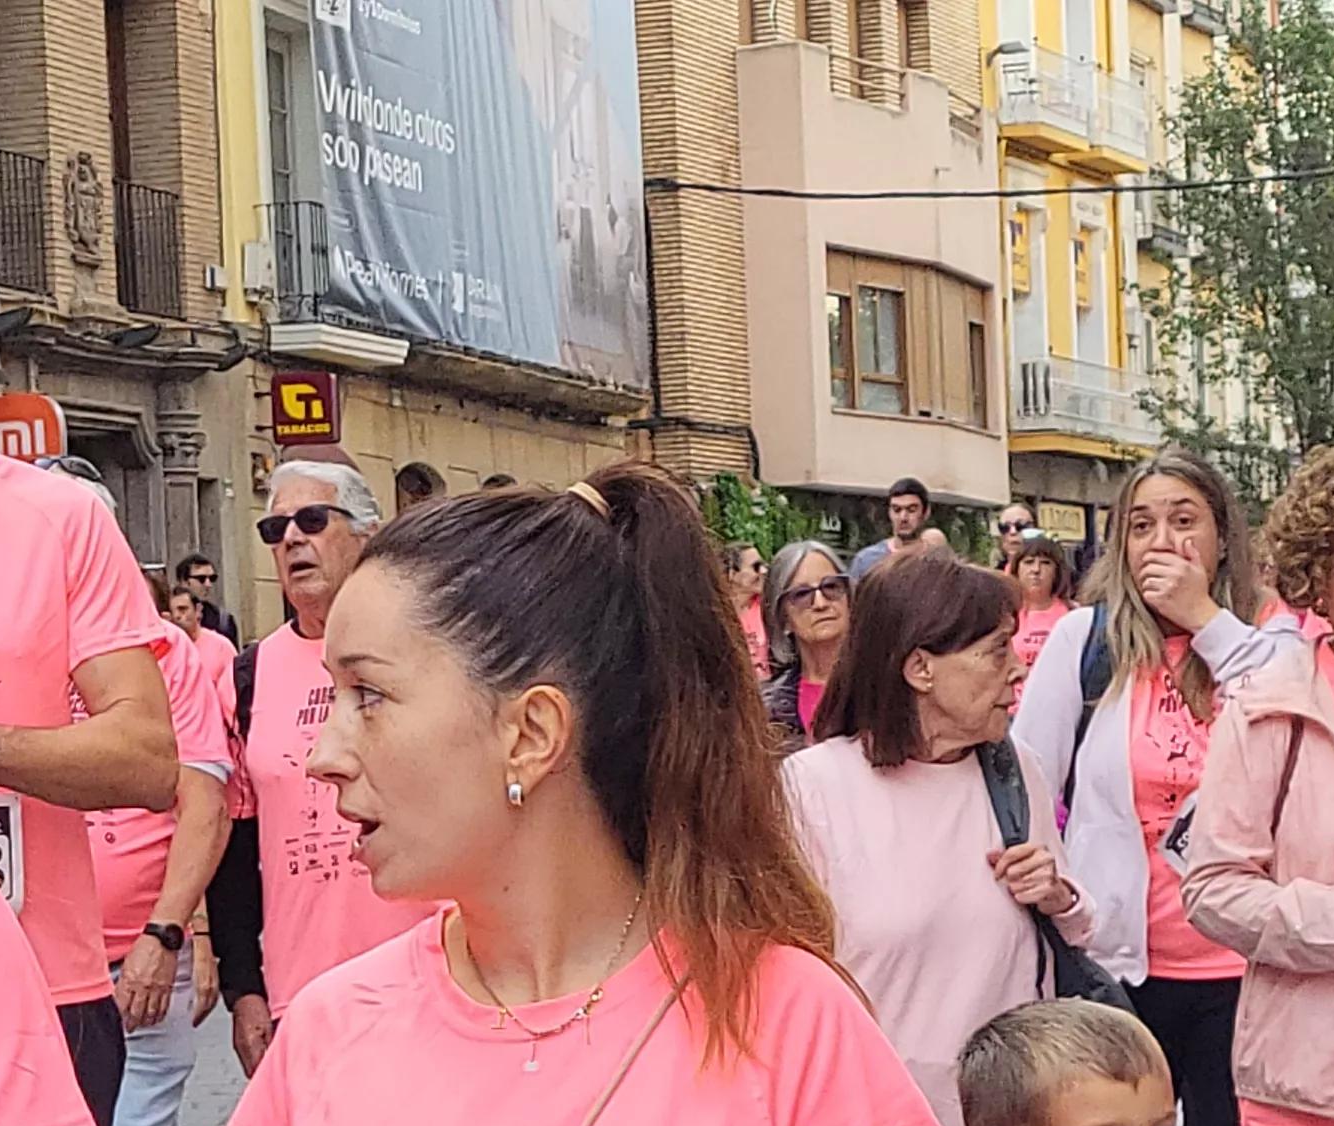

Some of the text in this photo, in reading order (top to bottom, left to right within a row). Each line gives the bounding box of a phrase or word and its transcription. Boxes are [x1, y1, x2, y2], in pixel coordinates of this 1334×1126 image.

[317, 70, 362, 123] Vvir
[415, 108, 455, 155] otros
[322, 132, 360, 173] soo
[276, 422, 331, 435] TABACOS
[296, 705, 330, 726] POR LA
